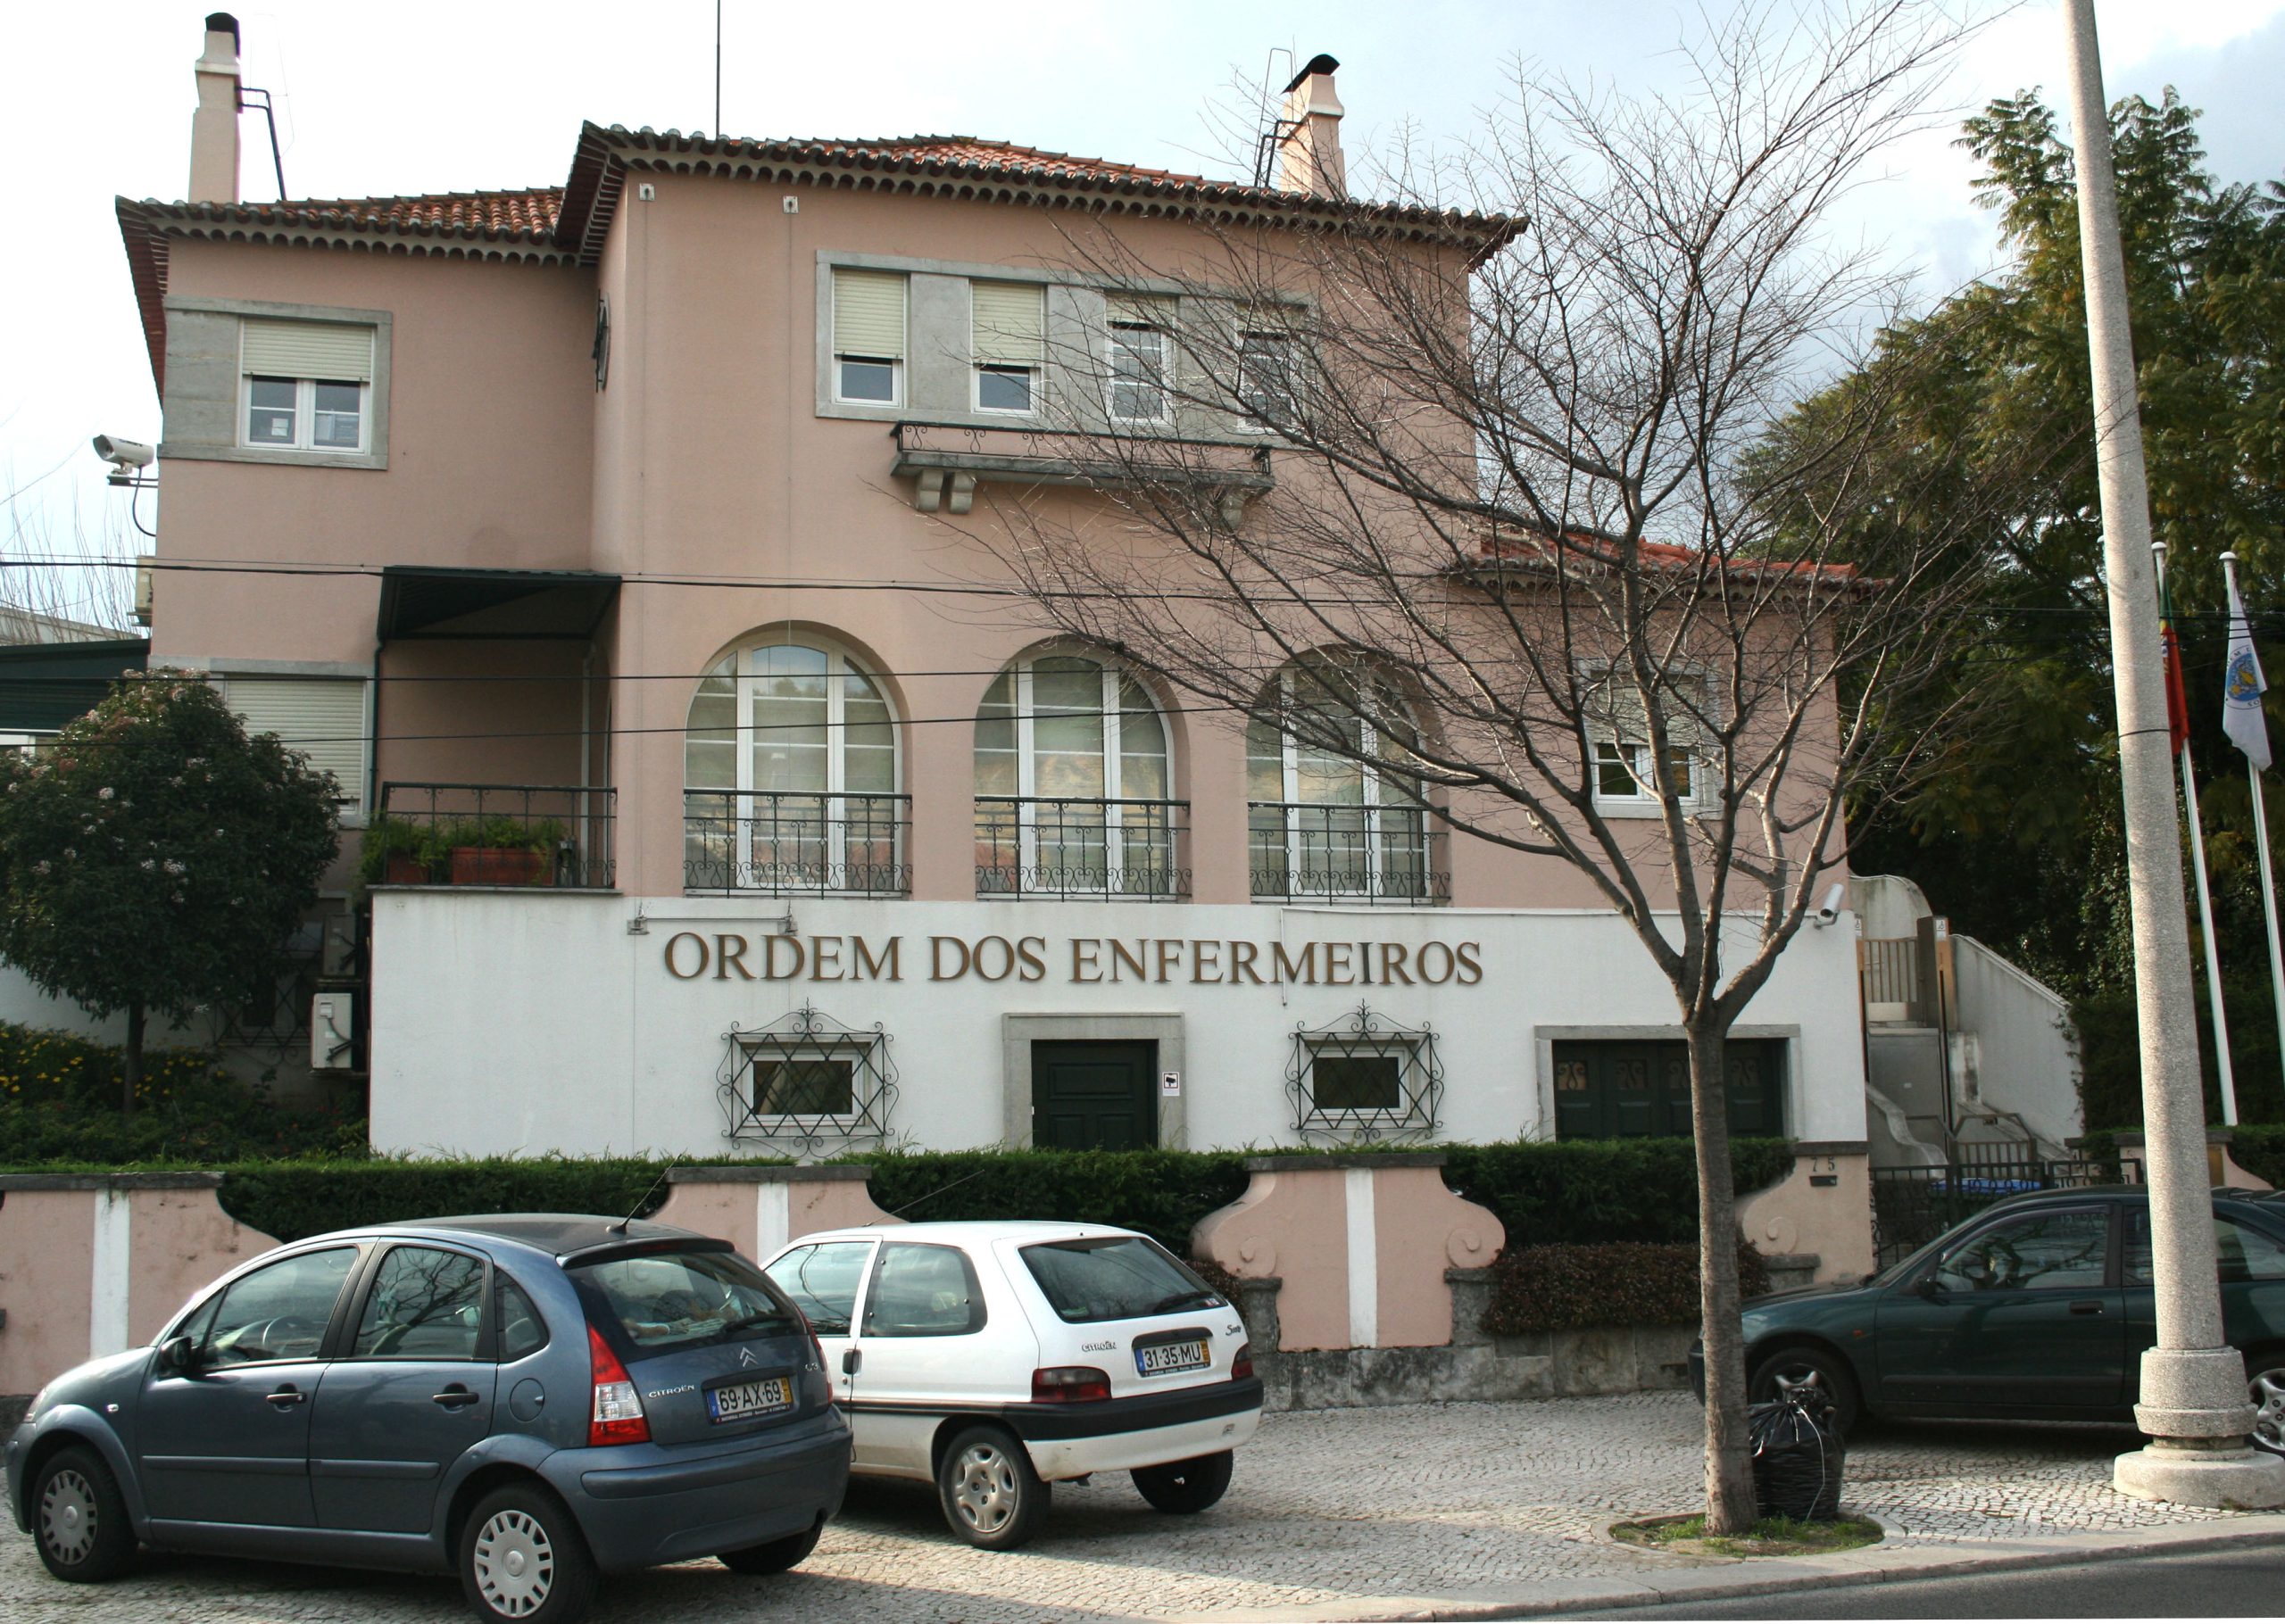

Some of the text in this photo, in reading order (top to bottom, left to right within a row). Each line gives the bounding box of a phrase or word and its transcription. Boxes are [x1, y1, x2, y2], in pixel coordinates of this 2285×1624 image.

[664, 932, 1483, 986] ORDEM DOS ENFERMEIROS
[1810, 1156, 1835, 1172] 75
[648, 1385, 695, 1398] CITROËN
